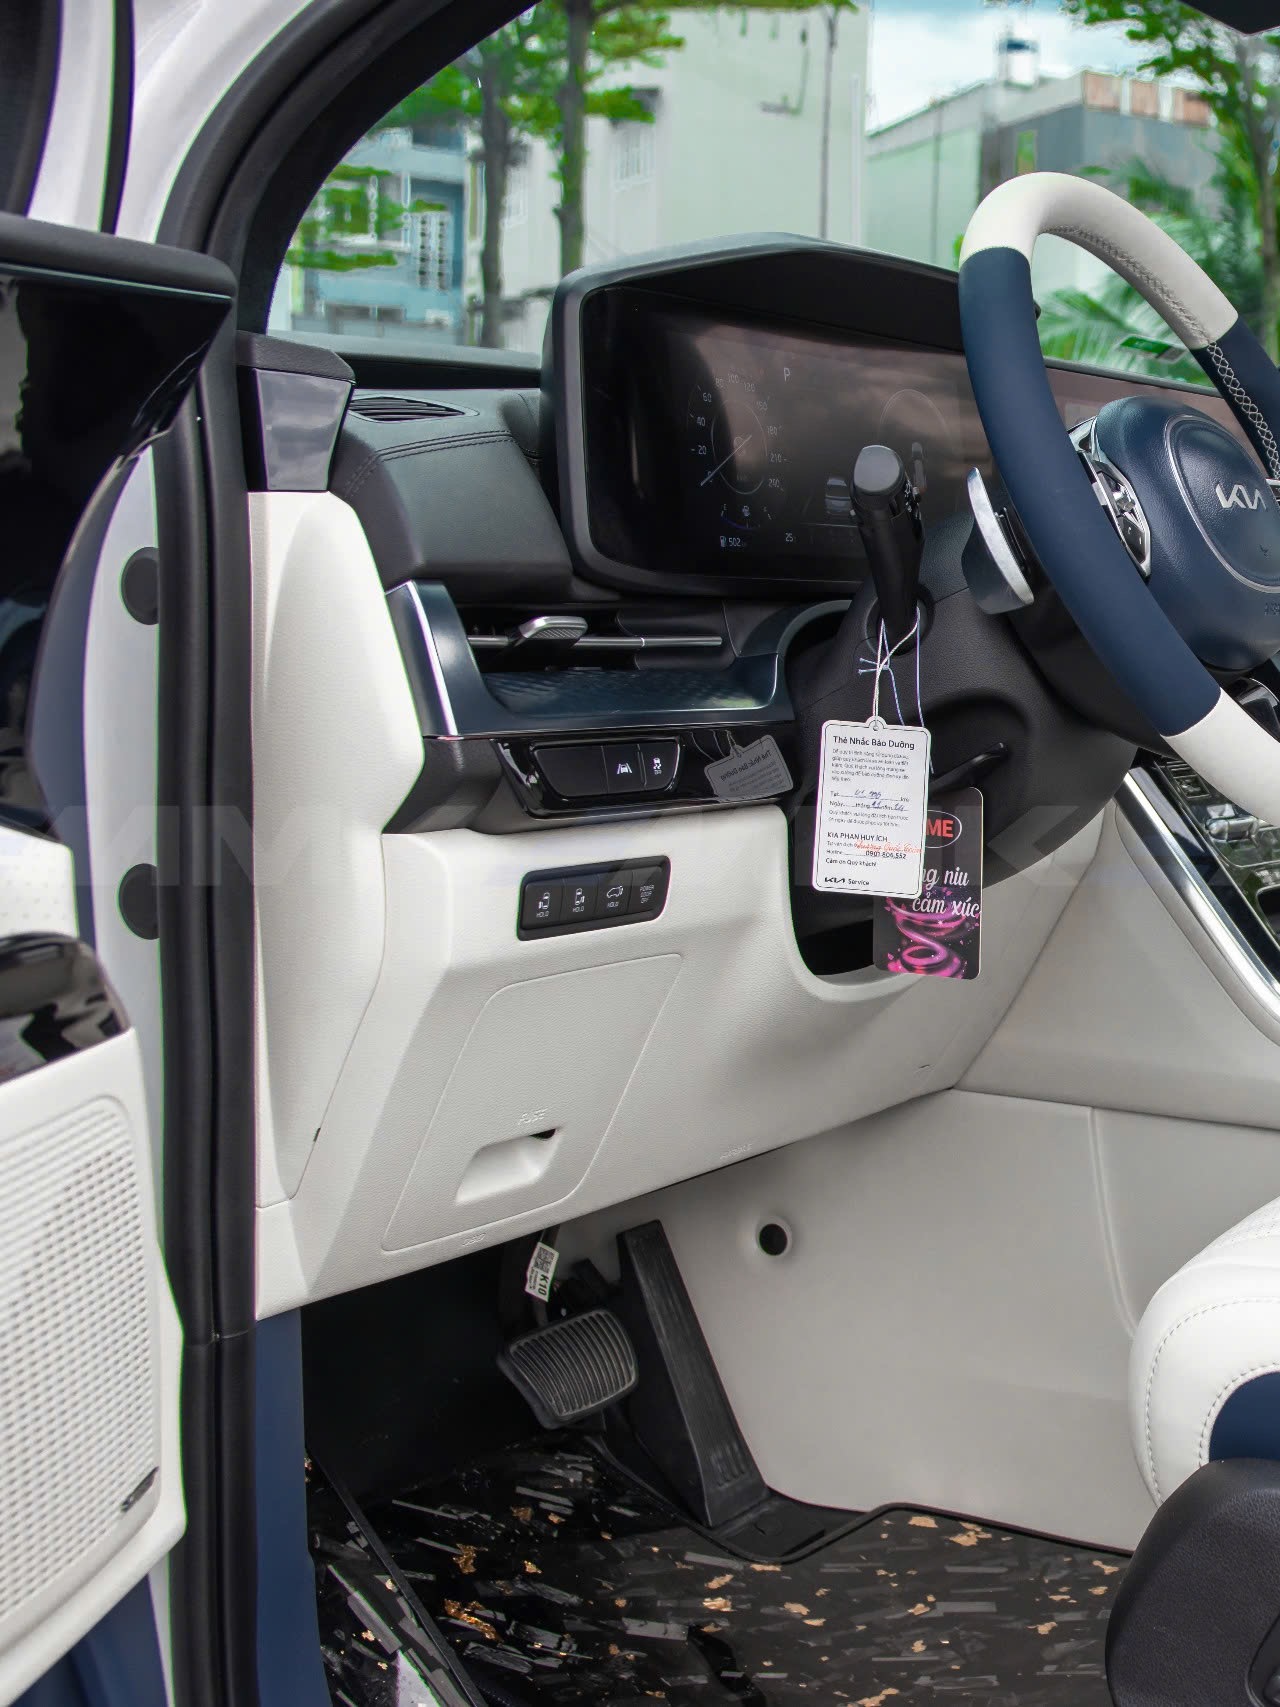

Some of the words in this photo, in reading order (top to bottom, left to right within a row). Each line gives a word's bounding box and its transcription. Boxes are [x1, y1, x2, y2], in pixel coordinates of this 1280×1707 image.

[702, 392, 712, 403] 60
[698, 445, 707, 455] 20
[848, 878, 870, 886] Service
[912, 891, 947, 914] cảm
[952, 897, 981, 918] xúc
